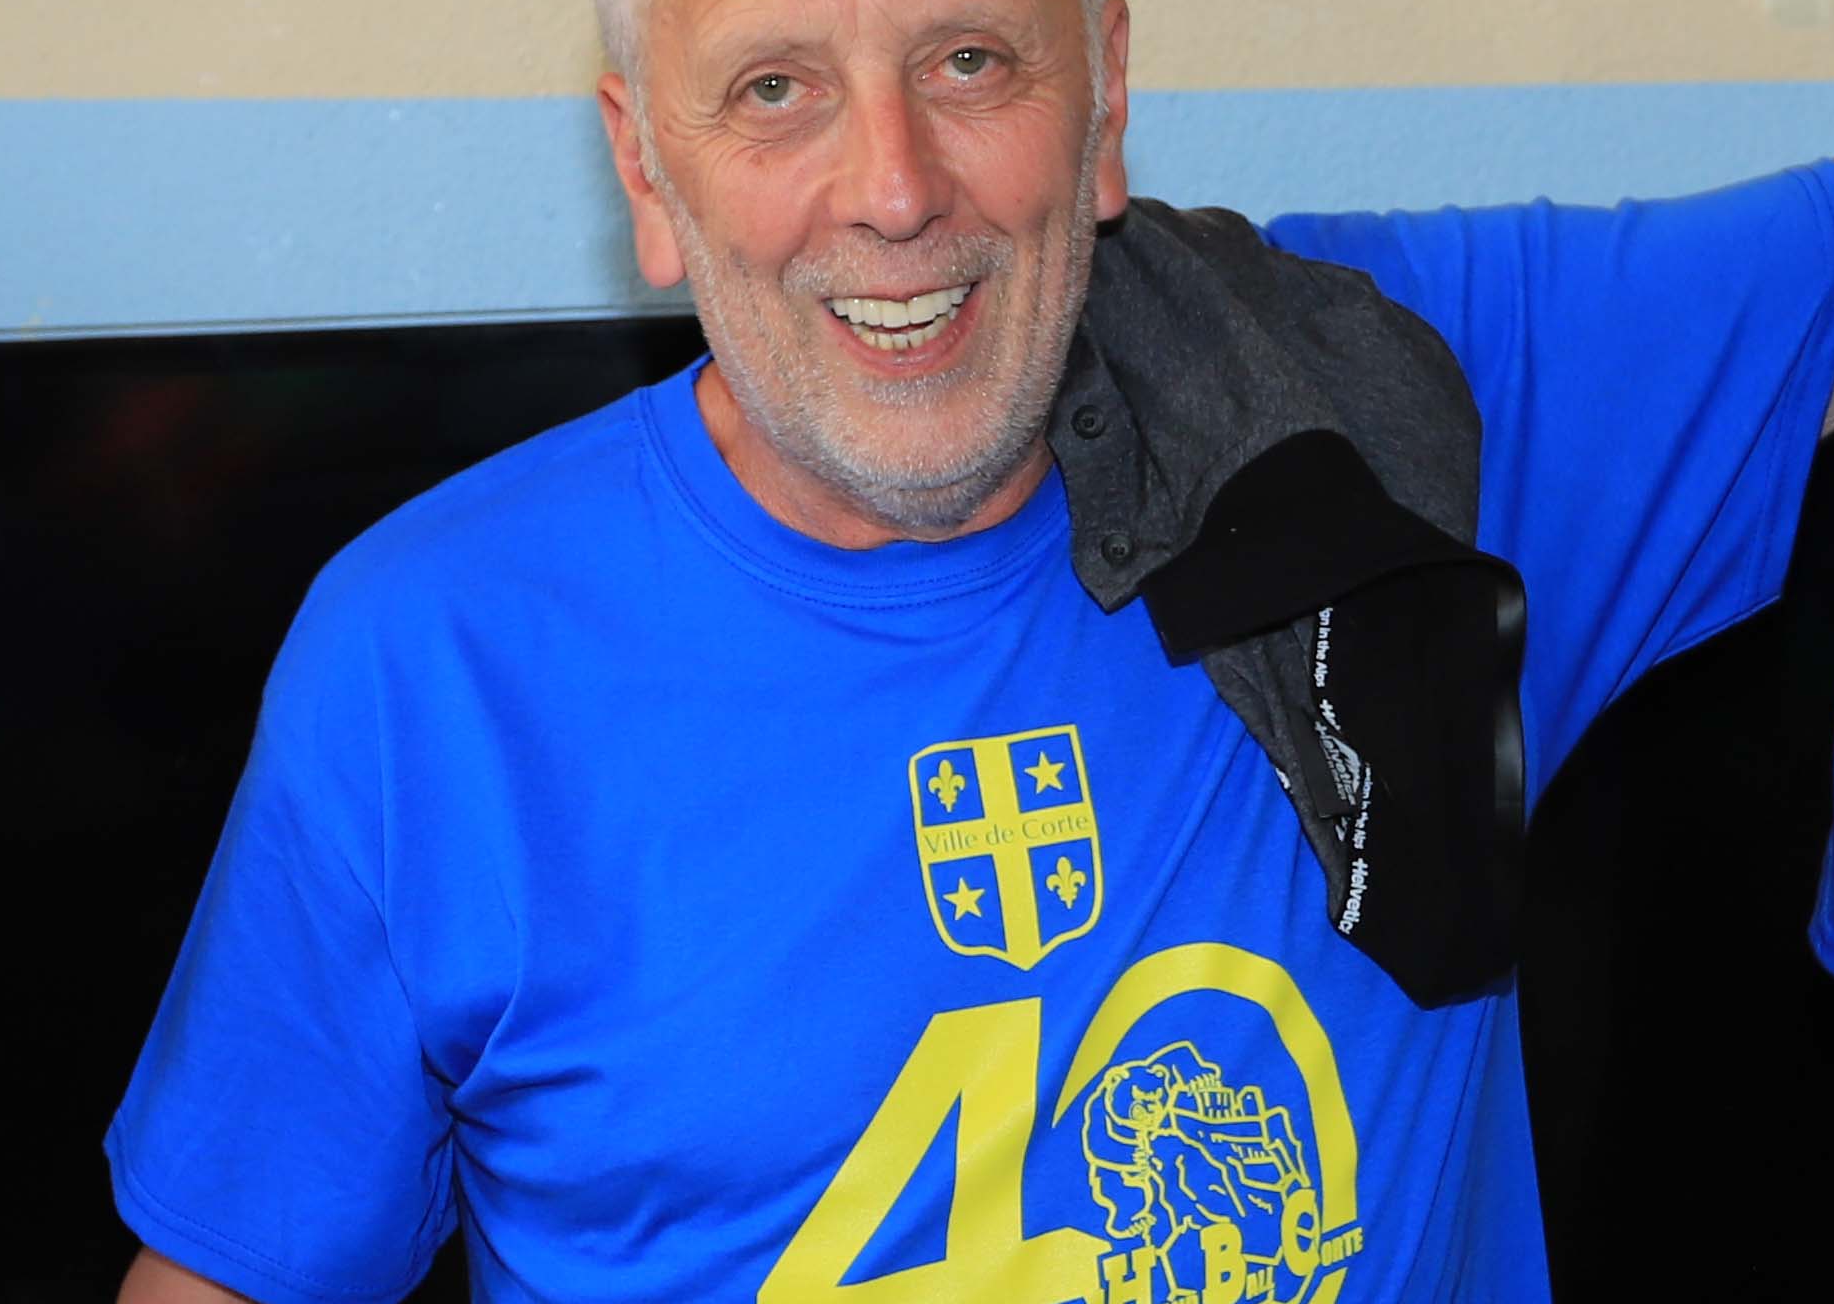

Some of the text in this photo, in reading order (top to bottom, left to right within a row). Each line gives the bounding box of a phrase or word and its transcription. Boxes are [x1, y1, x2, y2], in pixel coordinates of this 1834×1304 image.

[924, 814, 1089, 854] Ville de Corte
